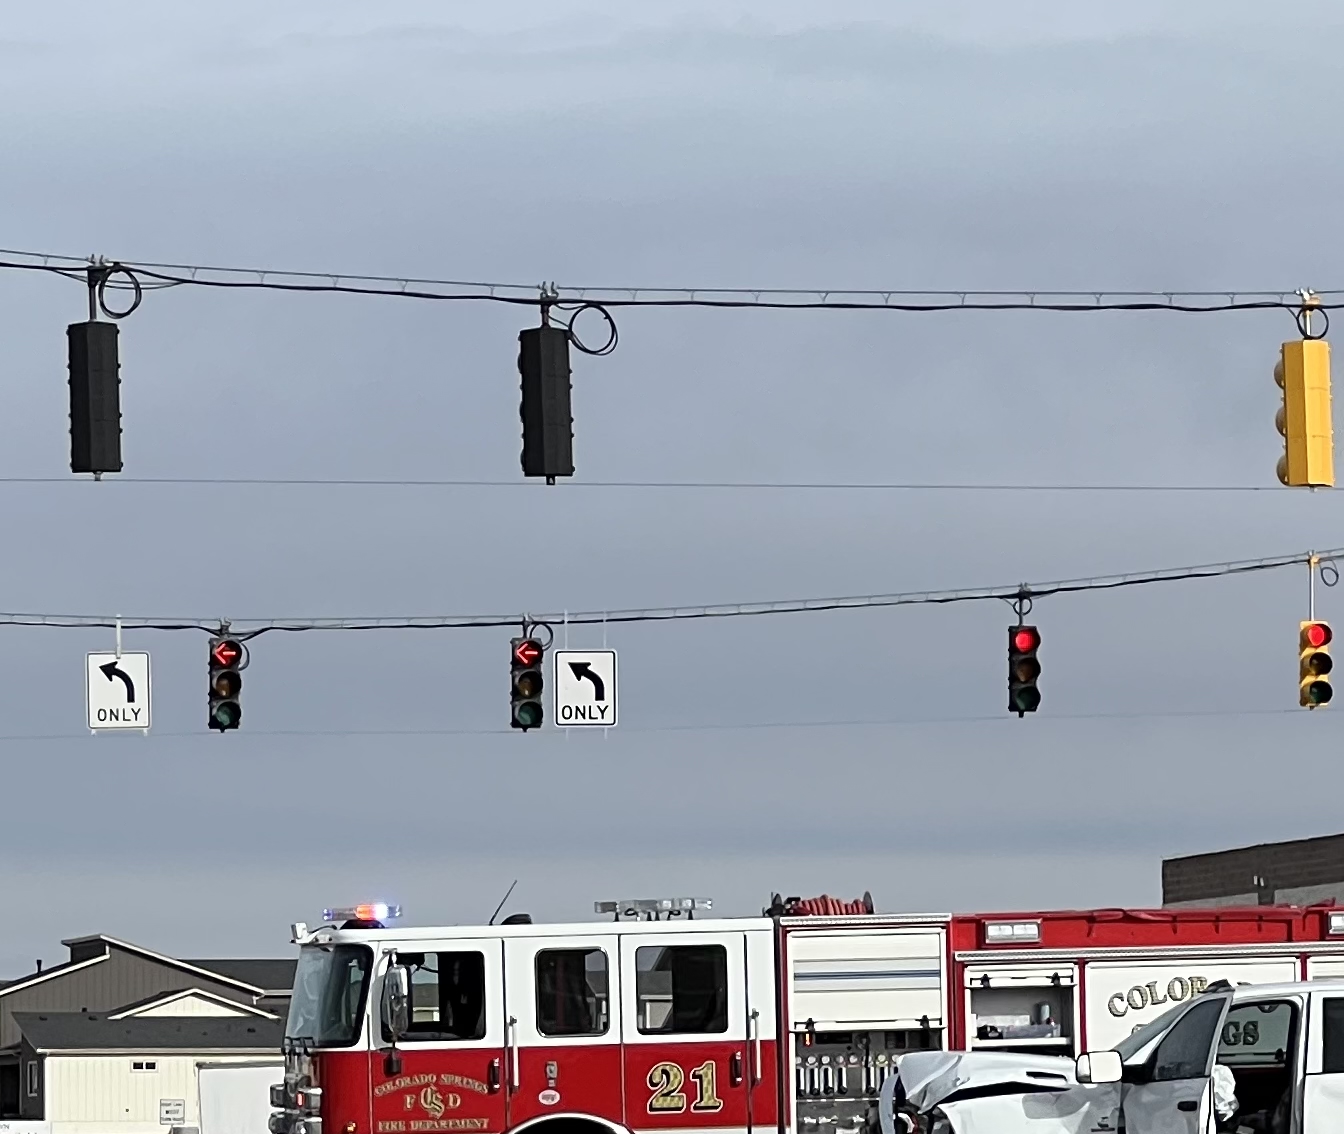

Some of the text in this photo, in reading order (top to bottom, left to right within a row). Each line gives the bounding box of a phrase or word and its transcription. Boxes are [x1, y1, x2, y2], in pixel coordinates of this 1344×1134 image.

[97, 707, 141, 721] ONLY
[561, 704, 609, 720] ONLY
[1108, 976, 1209, 1017] COLOR
[374, 1073, 489, 1097] COLORADO SPRINGS
[646, 1061, 724, 1115] 21
[404, 1094, 416, 1111] F
[446, 1093, 462, 1110] D
[377, 1118, 490, 1133] FIRE DEPARTMENT
